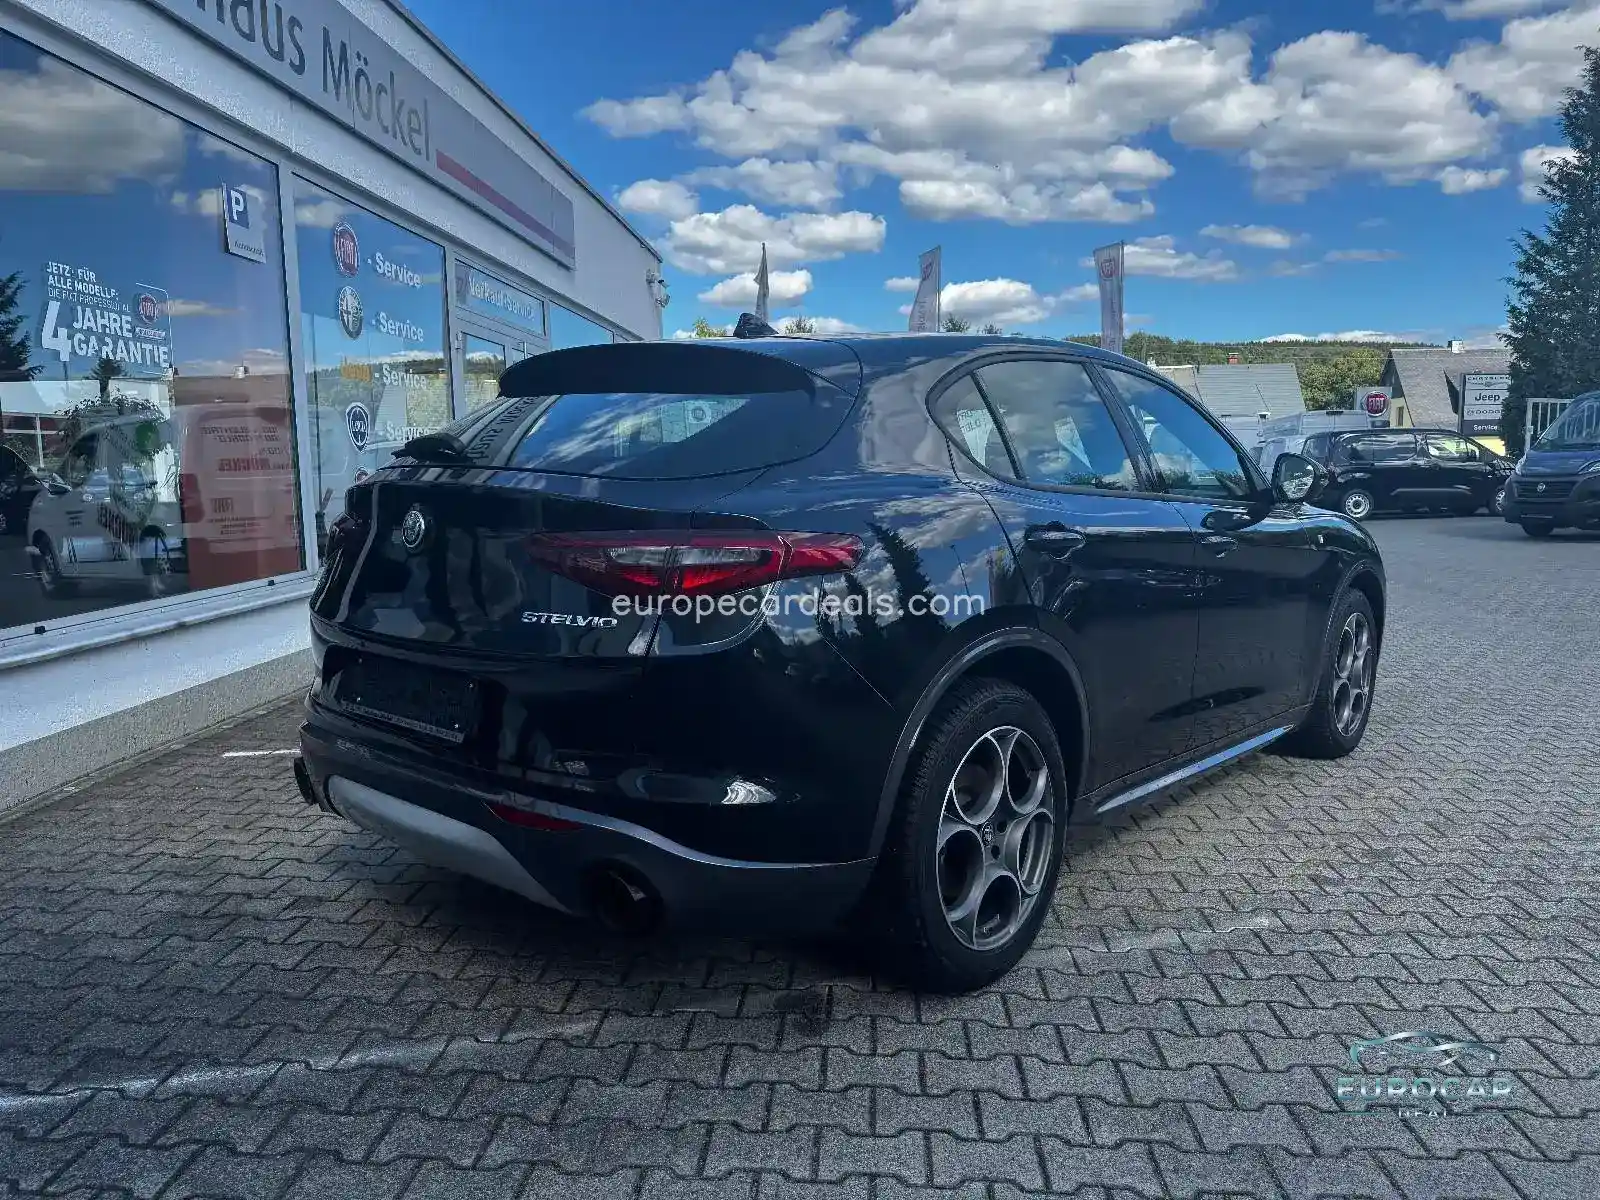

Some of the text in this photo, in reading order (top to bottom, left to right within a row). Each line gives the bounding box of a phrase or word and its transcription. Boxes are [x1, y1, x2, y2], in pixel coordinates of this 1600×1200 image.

[322, 26, 430, 161] Möckel
[230, 189, 244, 220] P
[47, 275, 73, 290] ALLE
[78, 266, 97, 282] FÜR
[375, 251, 421, 288] Service
[42, 300, 134, 361] 4 JAHRE
[379, 311, 424, 341] Service
[73, 332, 170, 368] GARANTIE
[383, 363, 427, 390] Service
[1368, 397, 1384, 411] FIAT
[1475, 392, 1500, 402] Jeep
[386, 420, 430, 441] Service
[521, 611, 618, 628] STELVIO
